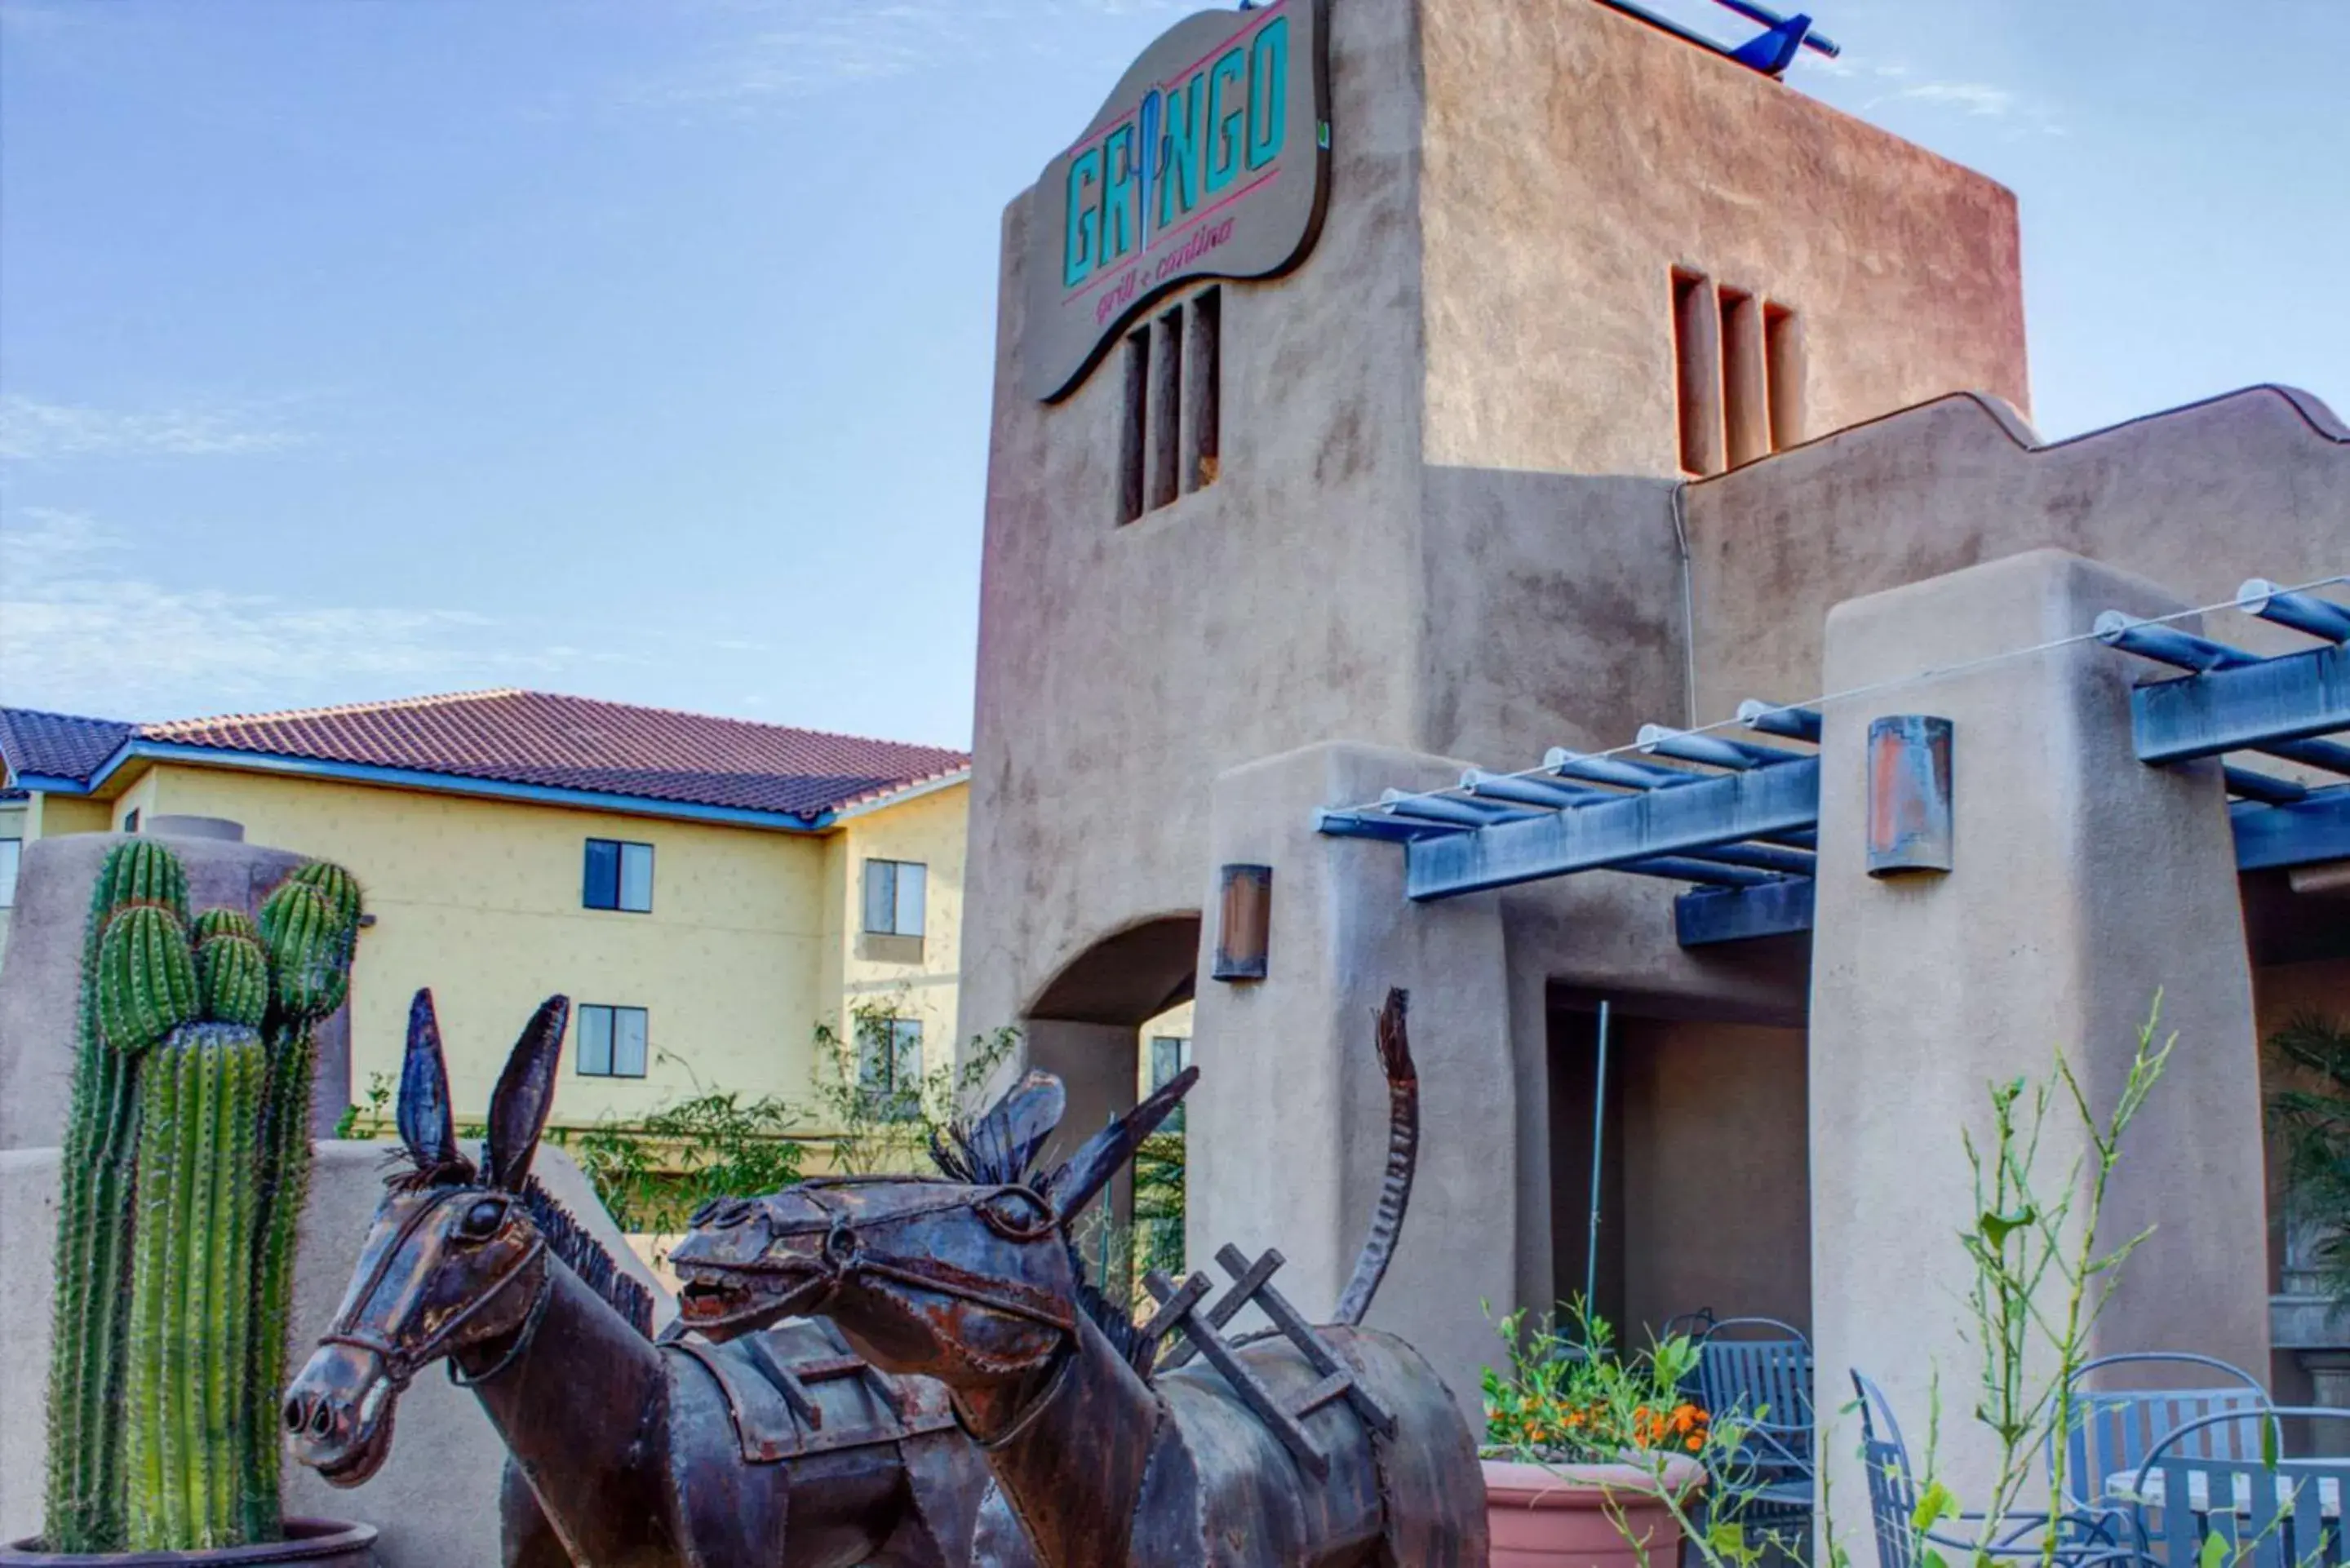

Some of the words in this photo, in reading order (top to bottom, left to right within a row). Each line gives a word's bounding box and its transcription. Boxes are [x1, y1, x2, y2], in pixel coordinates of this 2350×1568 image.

[1064, 16, 1288, 288] GRINGO
[1096, 268, 1138, 325] grill
[1155, 217, 1235, 280] cantina
